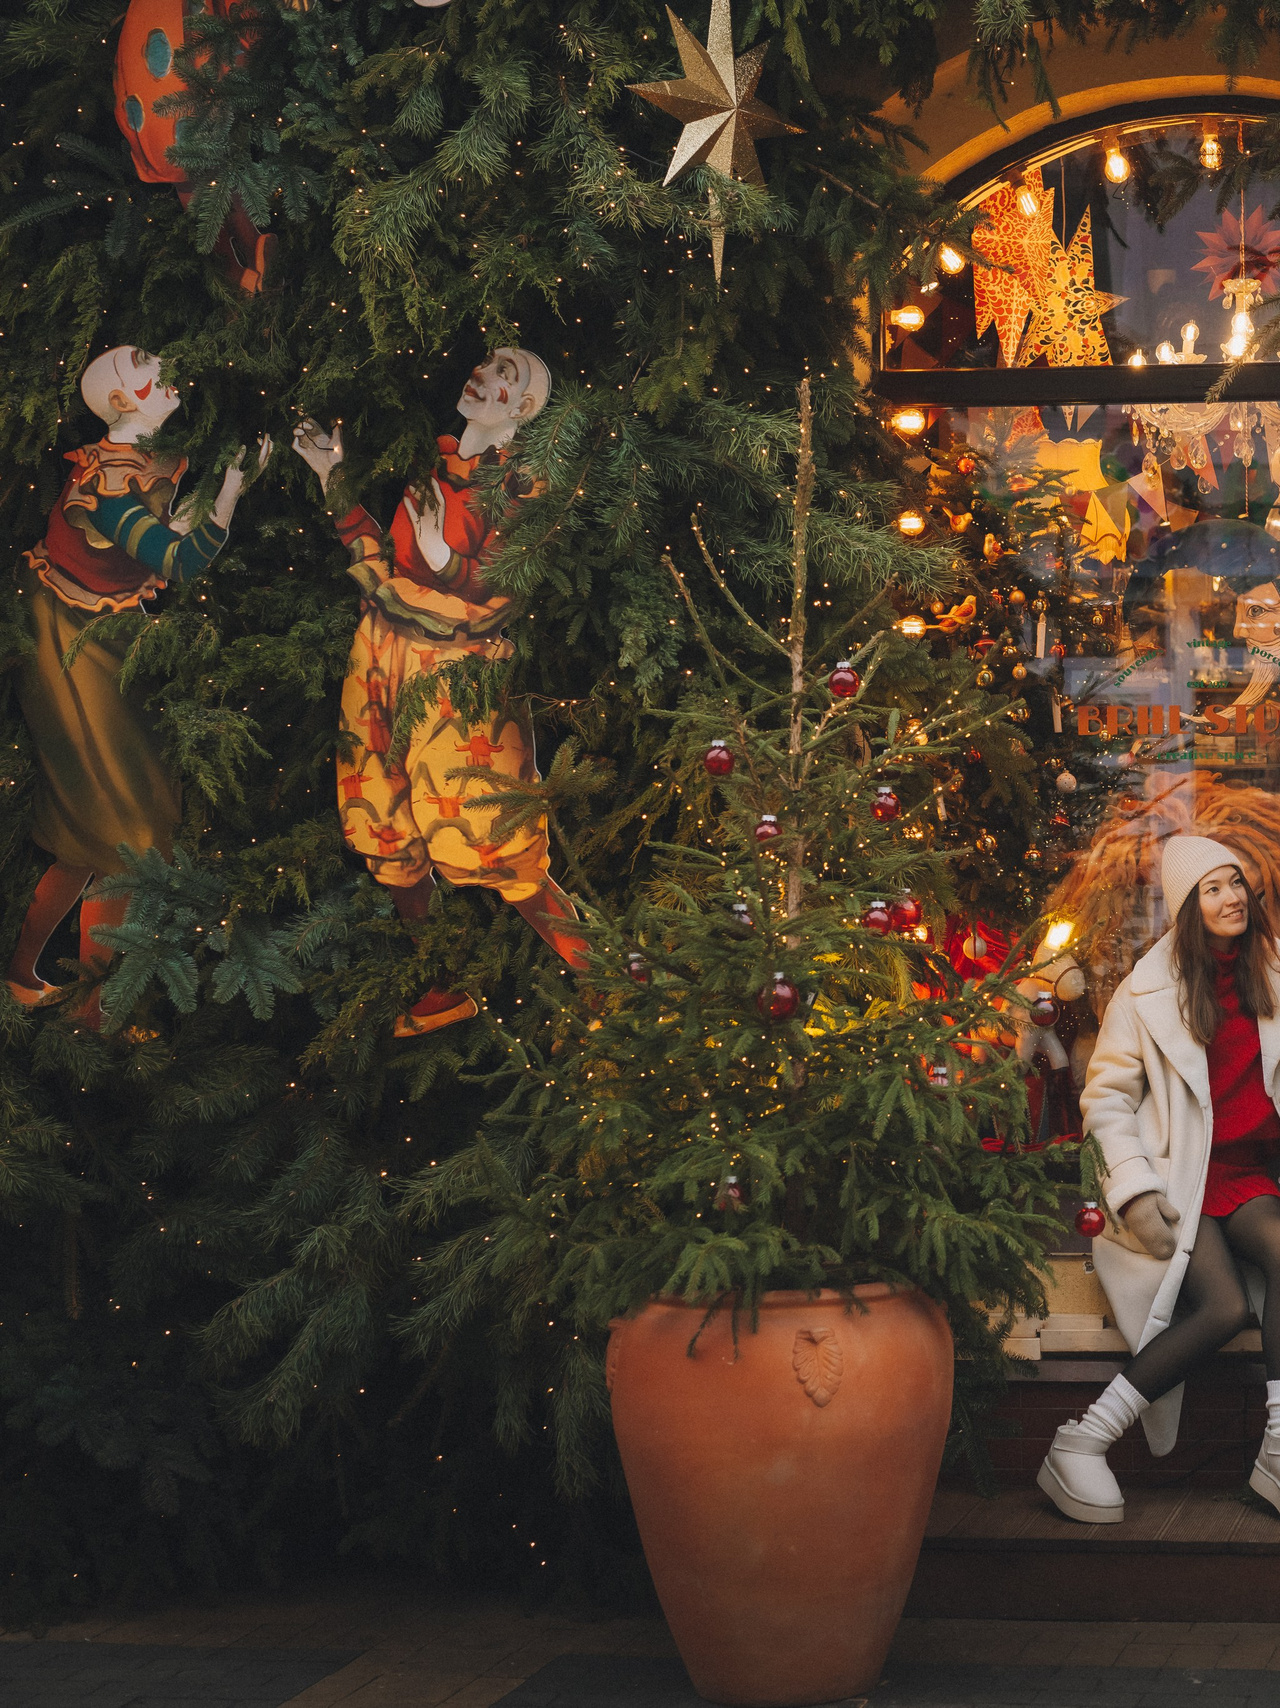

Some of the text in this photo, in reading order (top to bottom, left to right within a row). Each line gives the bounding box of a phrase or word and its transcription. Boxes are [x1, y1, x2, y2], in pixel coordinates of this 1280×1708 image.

[1186, 638, 1232, 649] vintage
[1113, 649, 1165, 688] souvenirs
[1186, 680, 1205, 689] est
[1077, 704, 1192, 736] BRHL
[1157, 751, 1257, 762] creative space
